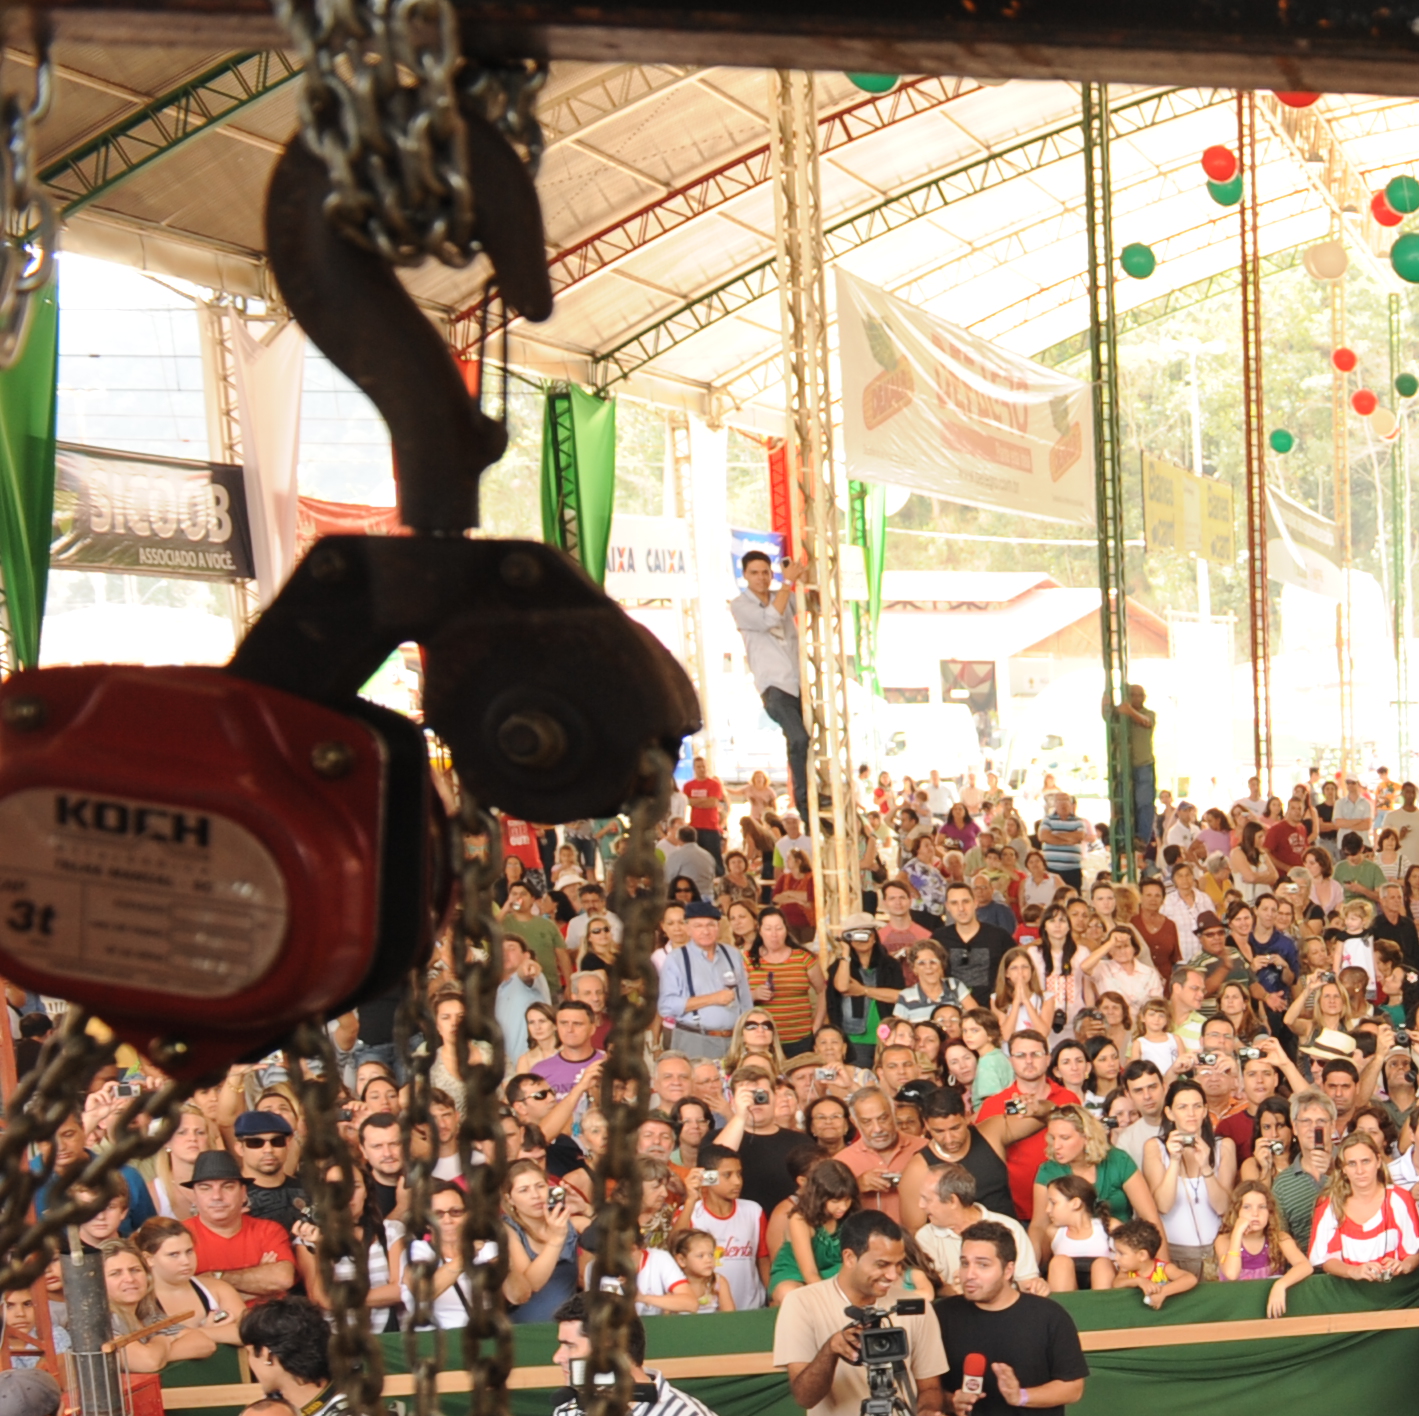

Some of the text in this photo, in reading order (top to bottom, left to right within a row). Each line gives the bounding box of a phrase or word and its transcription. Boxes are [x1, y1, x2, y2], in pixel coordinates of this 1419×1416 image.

[89, 470, 233, 543] SICOOB
[139, 546, 196, 568] ASSOCIADO
[198, 550, 207, 568] A
[606, 546, 686, 574] AIXA CAIXA
[56, 796, 210, 847] KOCH
[7, 899, 56, 936] 3t
